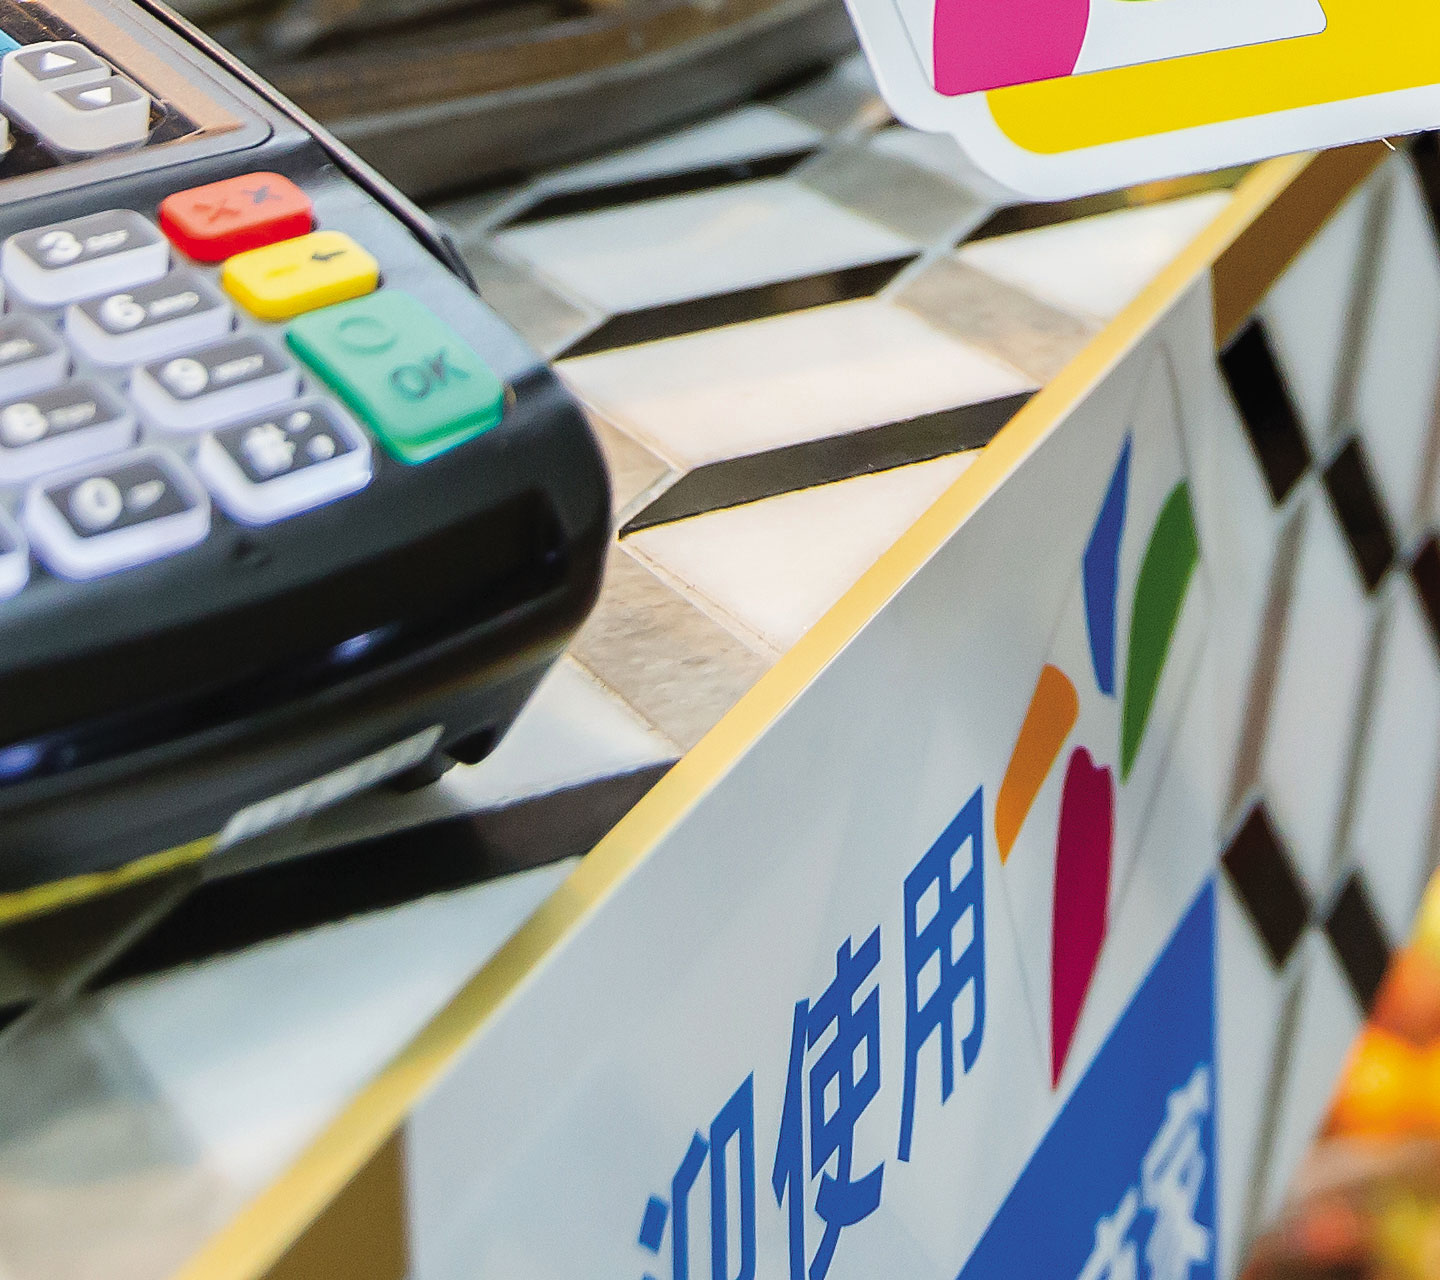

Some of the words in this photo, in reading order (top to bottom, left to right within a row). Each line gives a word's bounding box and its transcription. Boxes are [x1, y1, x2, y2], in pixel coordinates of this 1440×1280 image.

[38, 230, 83, 265] 3
[100, 293, 146, 329] 6
[389, 346, 471, 401] OK
[68, 476, 123, 533] 0
